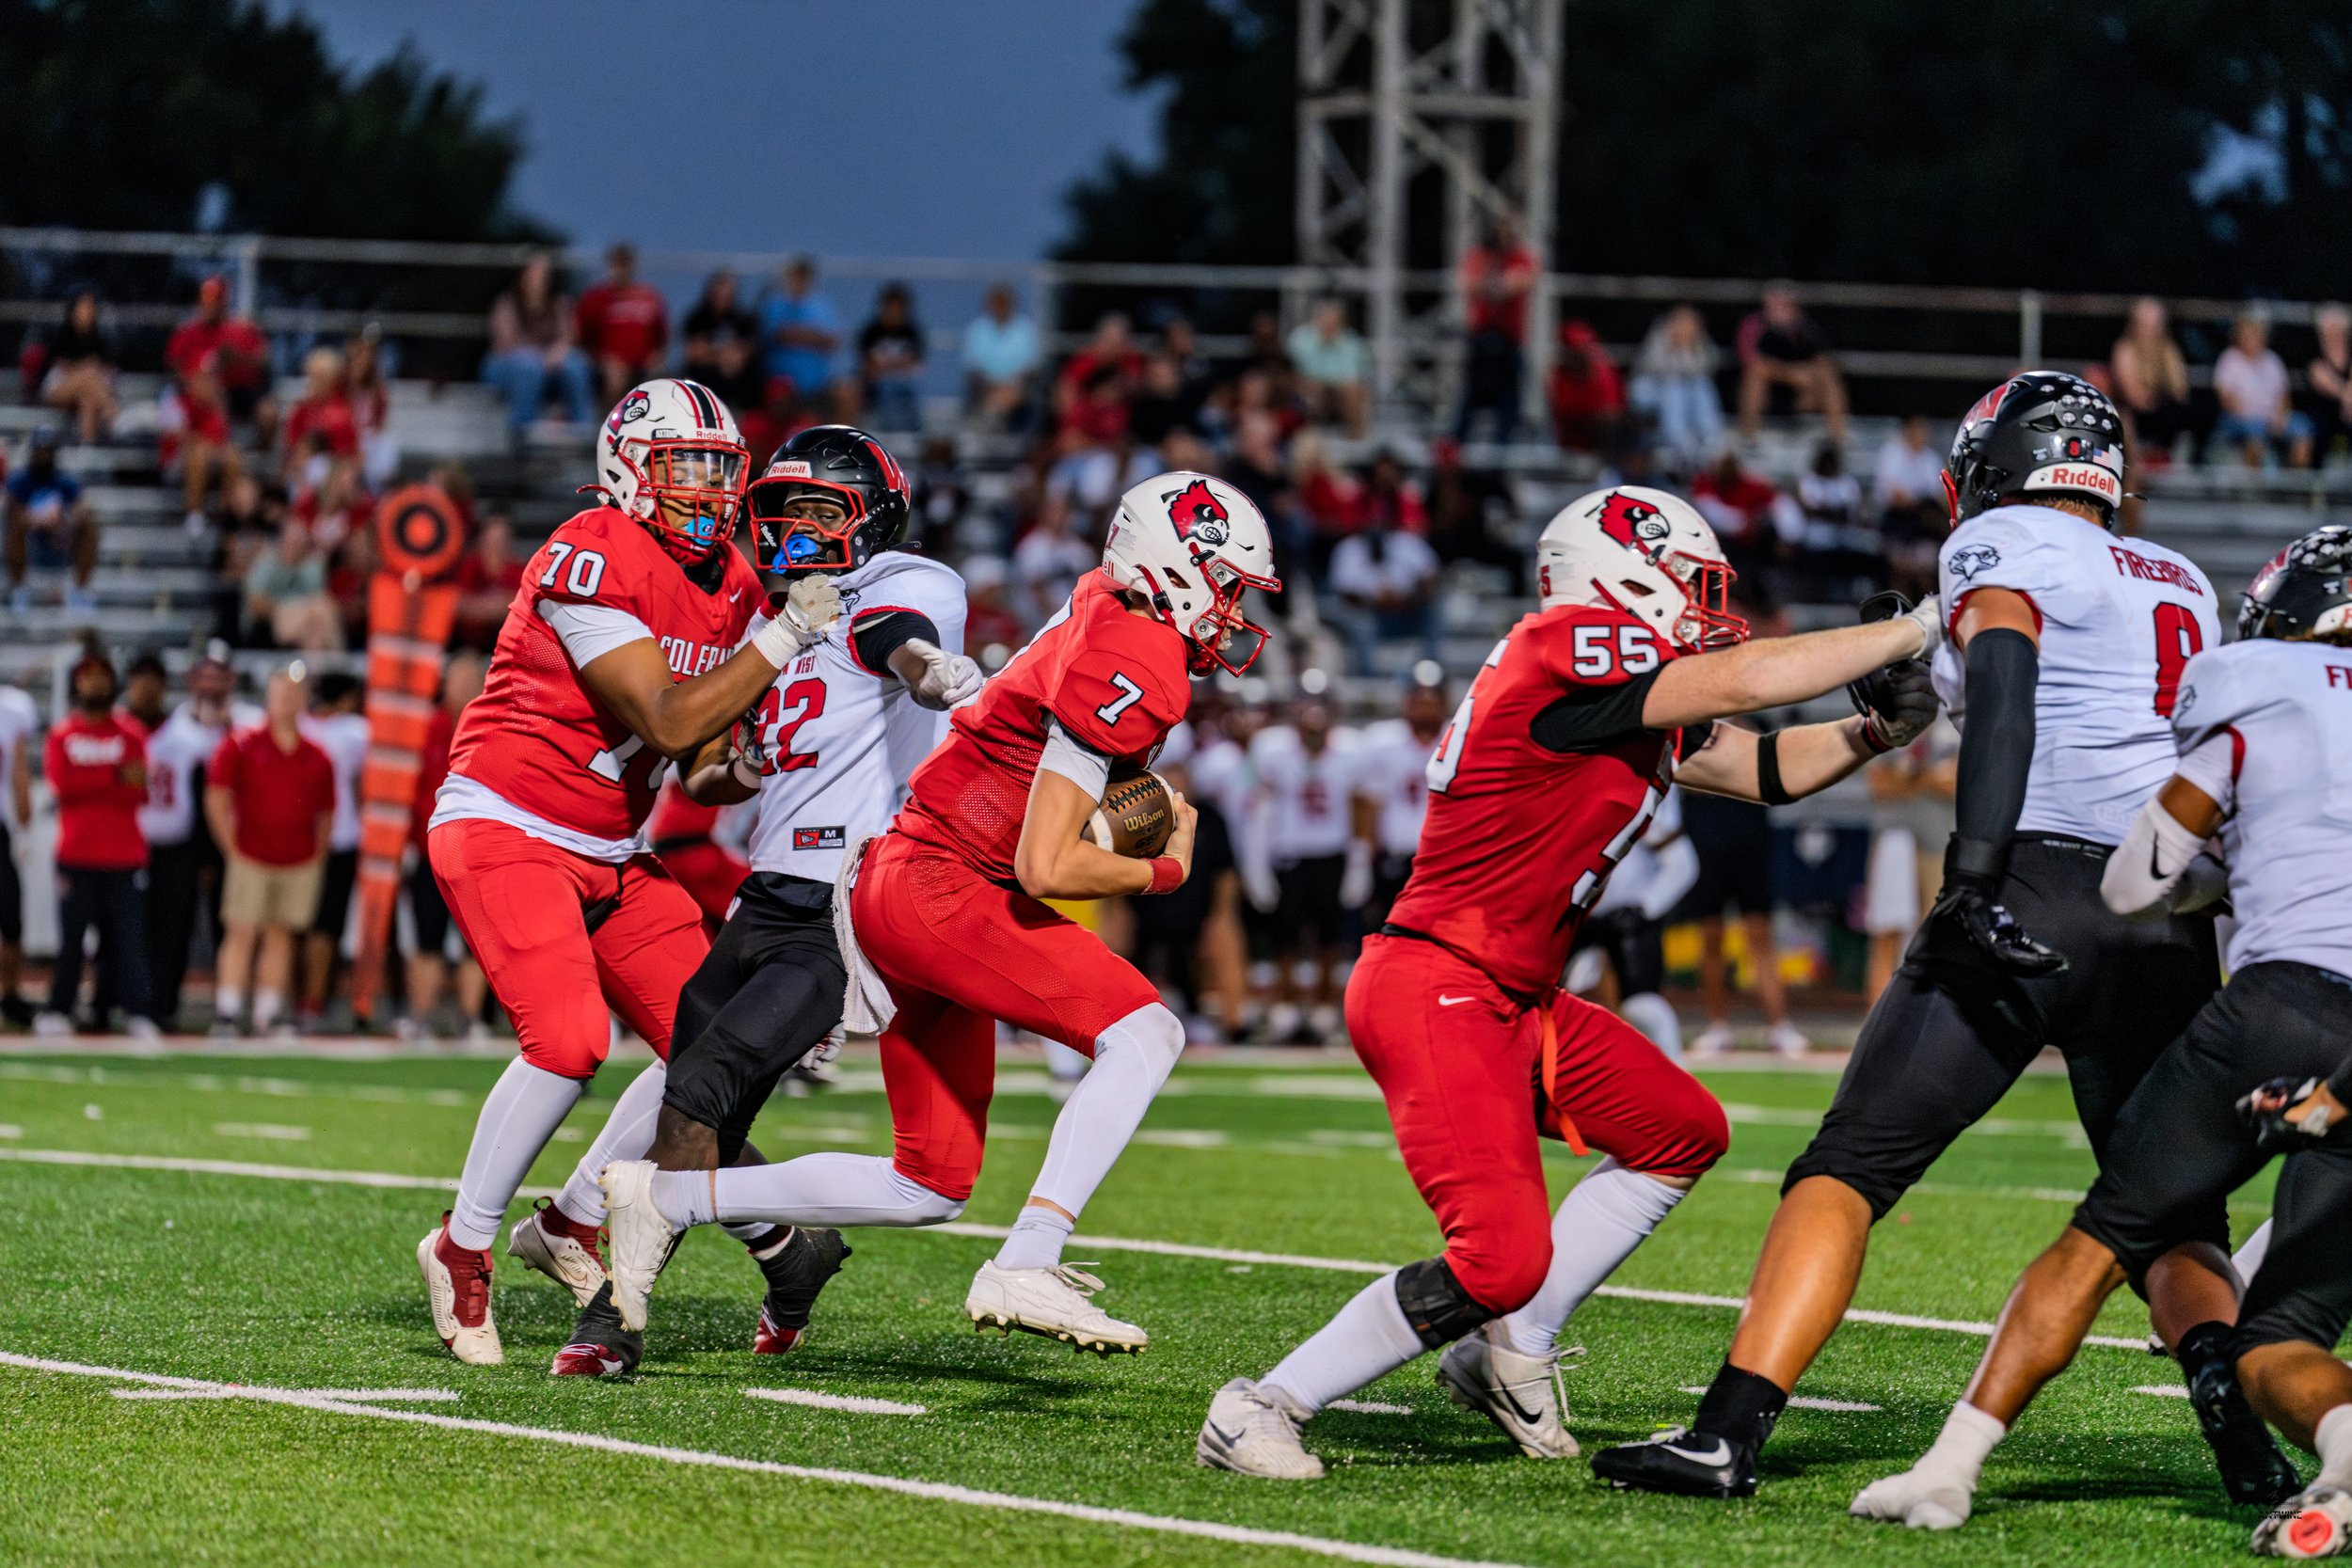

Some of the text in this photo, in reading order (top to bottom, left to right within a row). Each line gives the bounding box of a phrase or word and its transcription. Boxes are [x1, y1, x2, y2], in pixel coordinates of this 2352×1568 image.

[696, 431, 728, 441] Riddell
[771, 465, 806, 474] Riddell
[2052, 467, 2115, 496] Riddell
[540, 541, 607, 598] 70
[2108, 545, 2203, 596] FIREBIRDS
[1572, 625, 1660, 677] 55
[1094, 669, 1145, 728] 7
[755, 677, 827, 777] 22
[824, 830, 836, 839] M
[1123, 809, 1165, 832] Wilson
